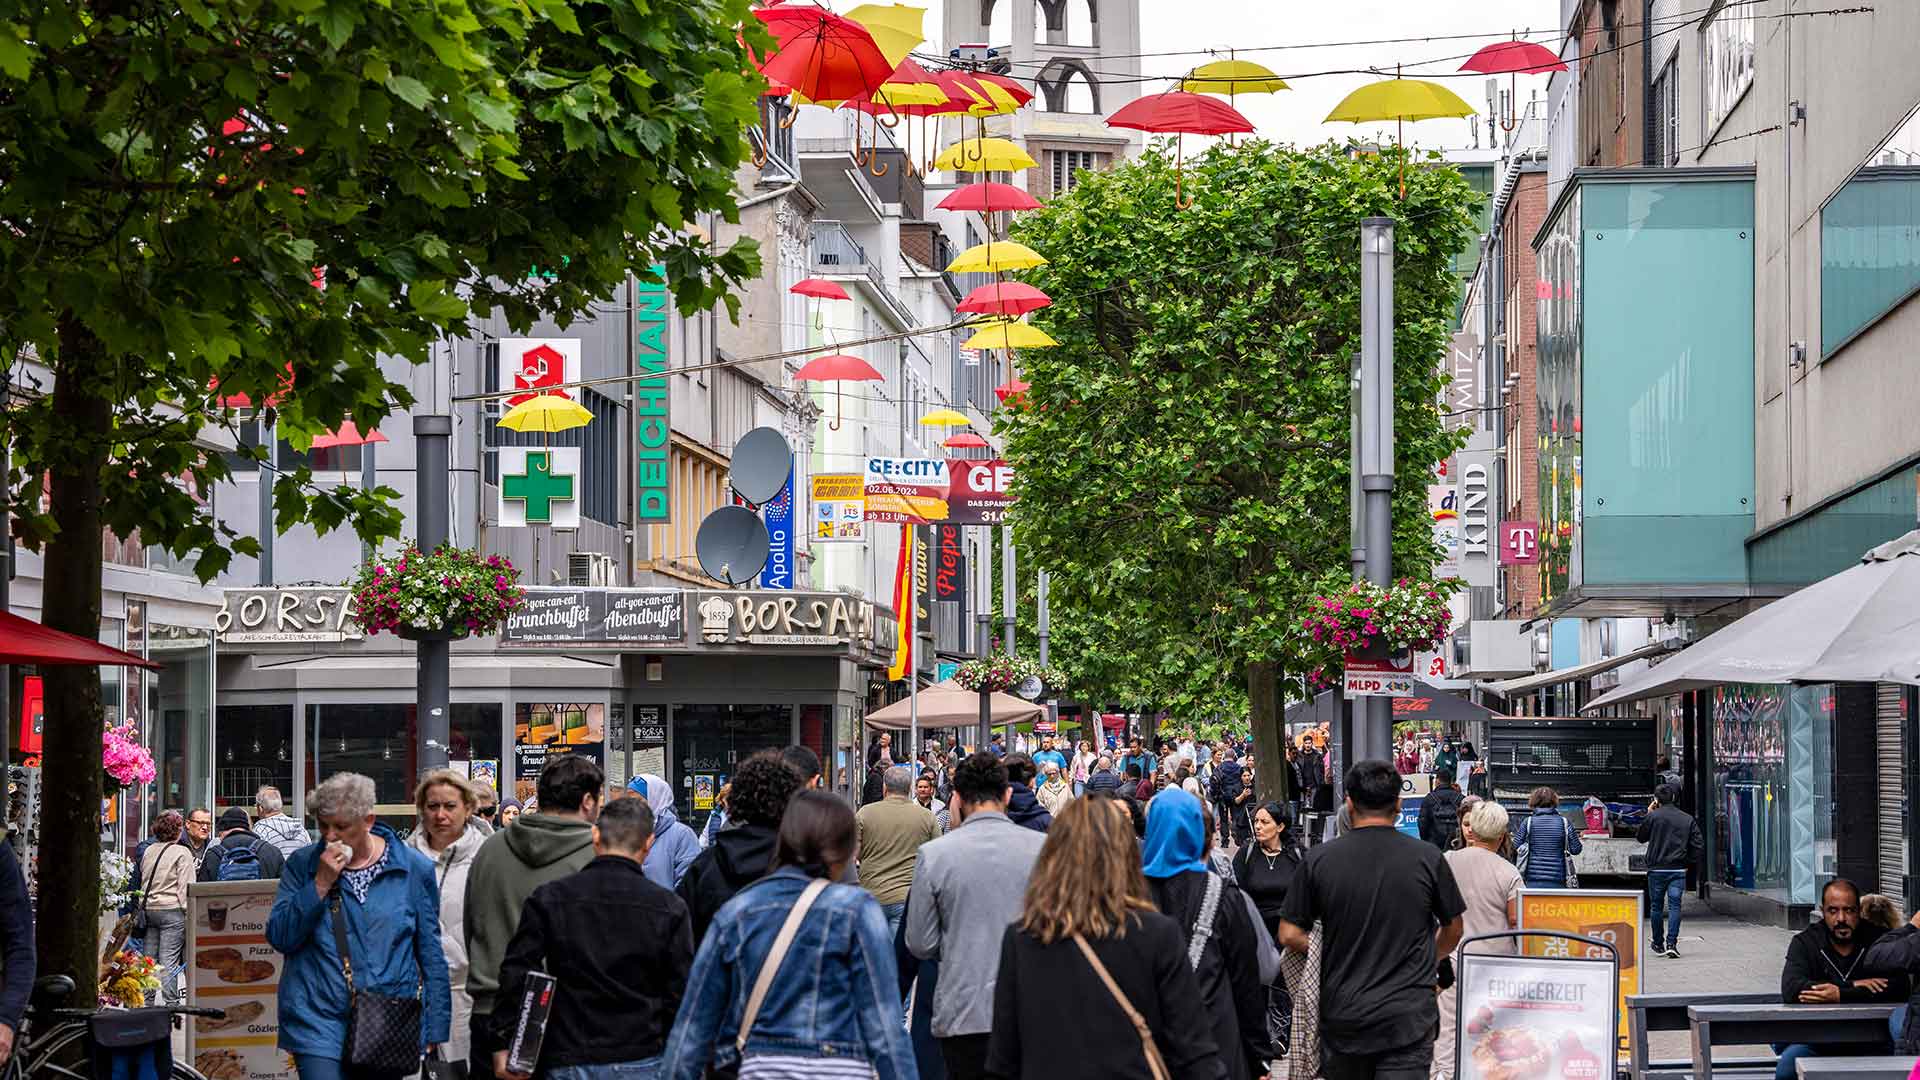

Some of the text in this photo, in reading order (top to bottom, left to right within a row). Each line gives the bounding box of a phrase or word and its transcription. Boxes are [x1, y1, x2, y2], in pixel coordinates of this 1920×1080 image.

[640, 264, 666, 519] DEICHMANN
[869, 459, 944, 476] GE:CITY
[1441, 490, 1458, 512] d
[1464, 464, 1488, 556] KIND
[868, 512, 909, 521] ab 13 Uhr
[1510, 528, 1534, 558] T
[769, 530, 785, 588] Apollo
[615, 593, 673, 610] all-you-can-eat
[507, 605, 589, 630] Brunchbuffet
[604, 604, 681, 630] Abendbuffet
[709, 611, 726, 621] 1855
[736, 596, 852, 636] BORSA
[1348, 680, 1380, 691] MLPD
[1406, 815, 1418, 823] für
[1529, 903, 1631, 919] GIGANTISCH
[232, 922, 263, 931] Tchibo
[249, 946, 275, 956] Pizza
[1489, 979, 1587, 1001] ERDBEERZEIT
